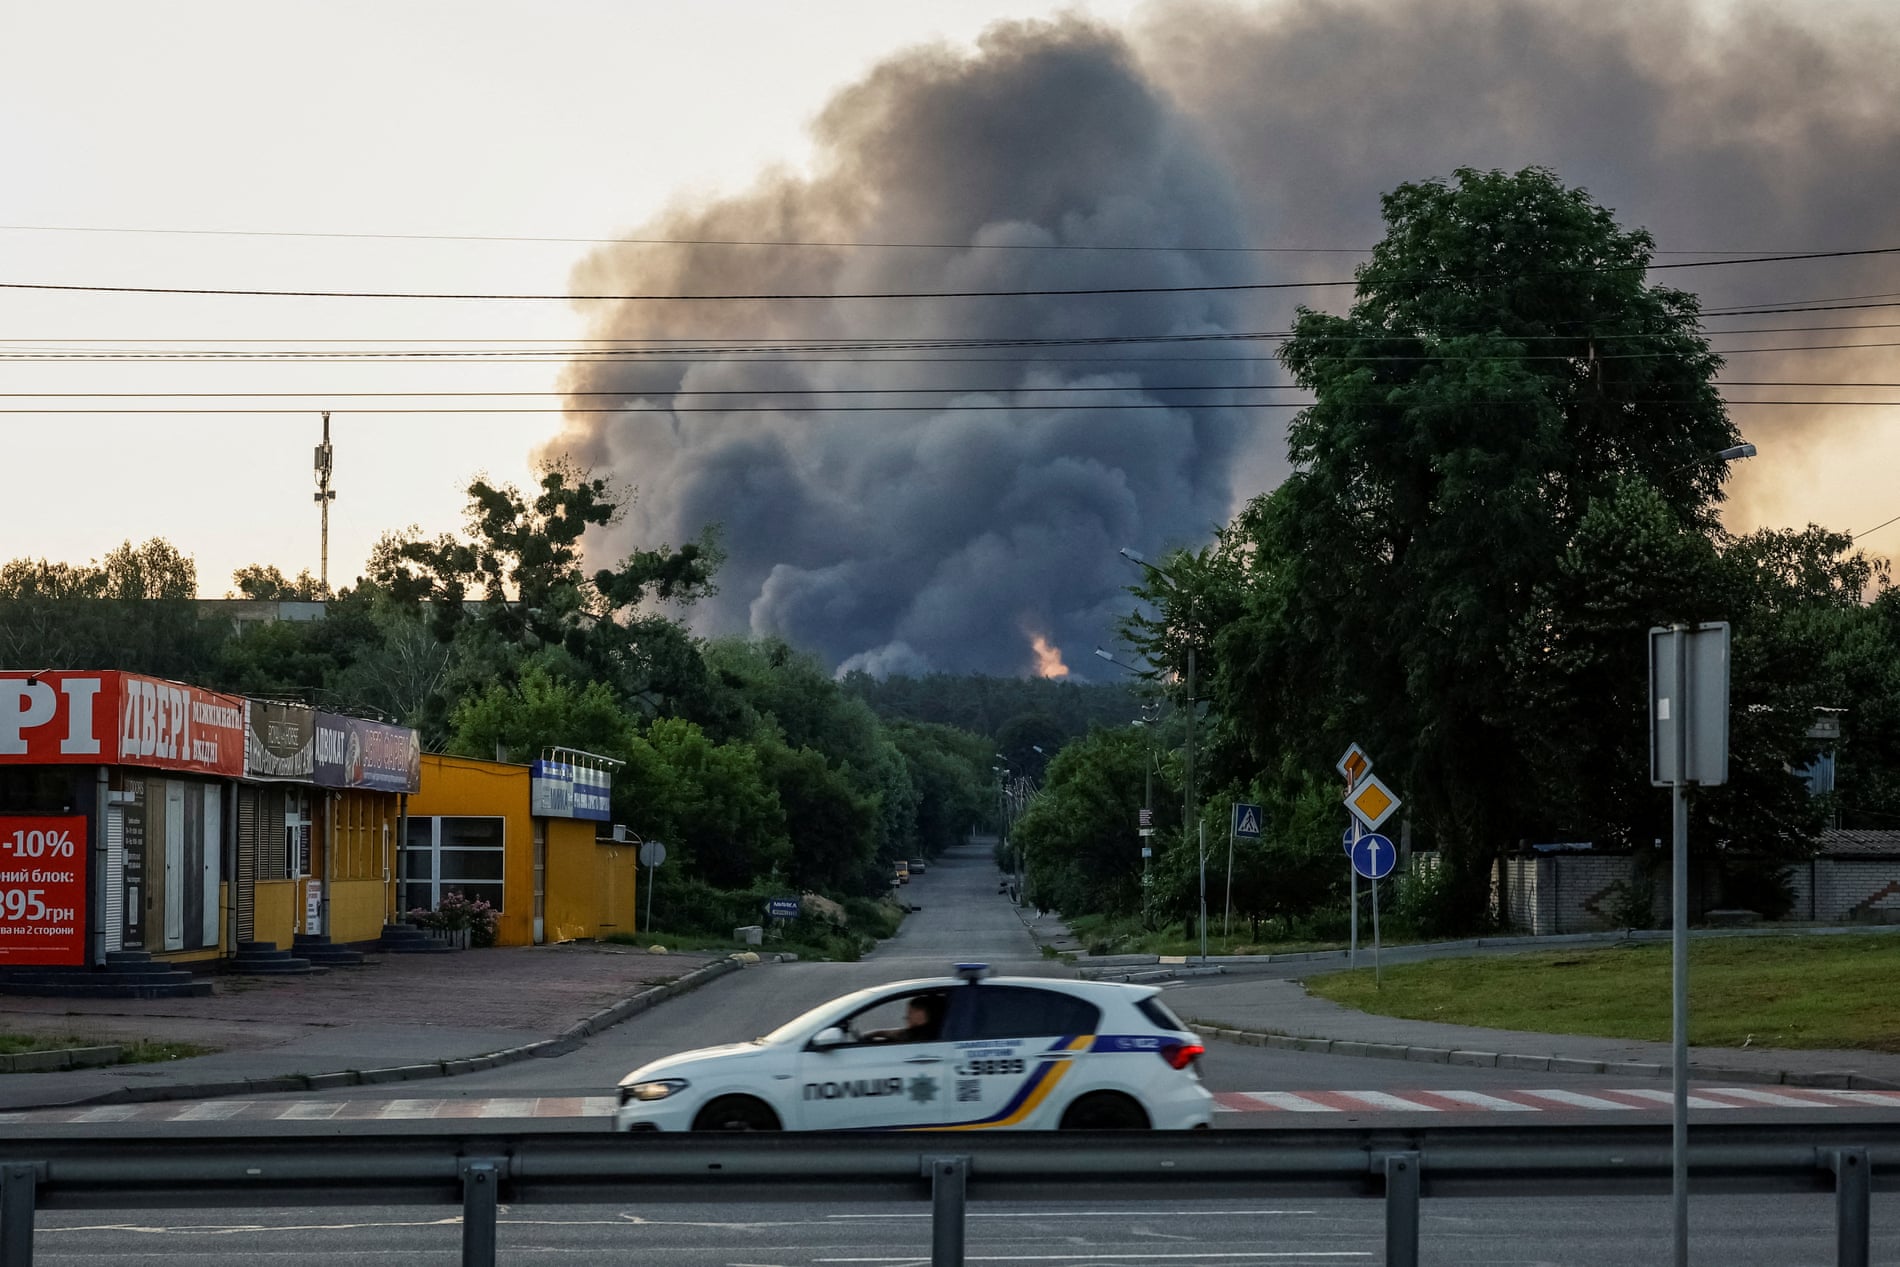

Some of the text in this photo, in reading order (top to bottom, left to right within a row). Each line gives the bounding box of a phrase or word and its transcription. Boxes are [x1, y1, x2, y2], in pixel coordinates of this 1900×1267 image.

[0, 678, 101, 754] РІ
[121, 679, 191, 760] ДВЕРІ
[193, 692, 242, 730] міжкімнатні
[193, 731, 218, 767] вхідні
[315, 726, 345, 767] АДВОКАТ
[2, 830, 75, 857] -10%
[0, 868, 75, 883] ний блок:
[14, 926, 26, 934] на
[26, 925, 33, 935] 2
[34, 926, 74, 936] сторони
